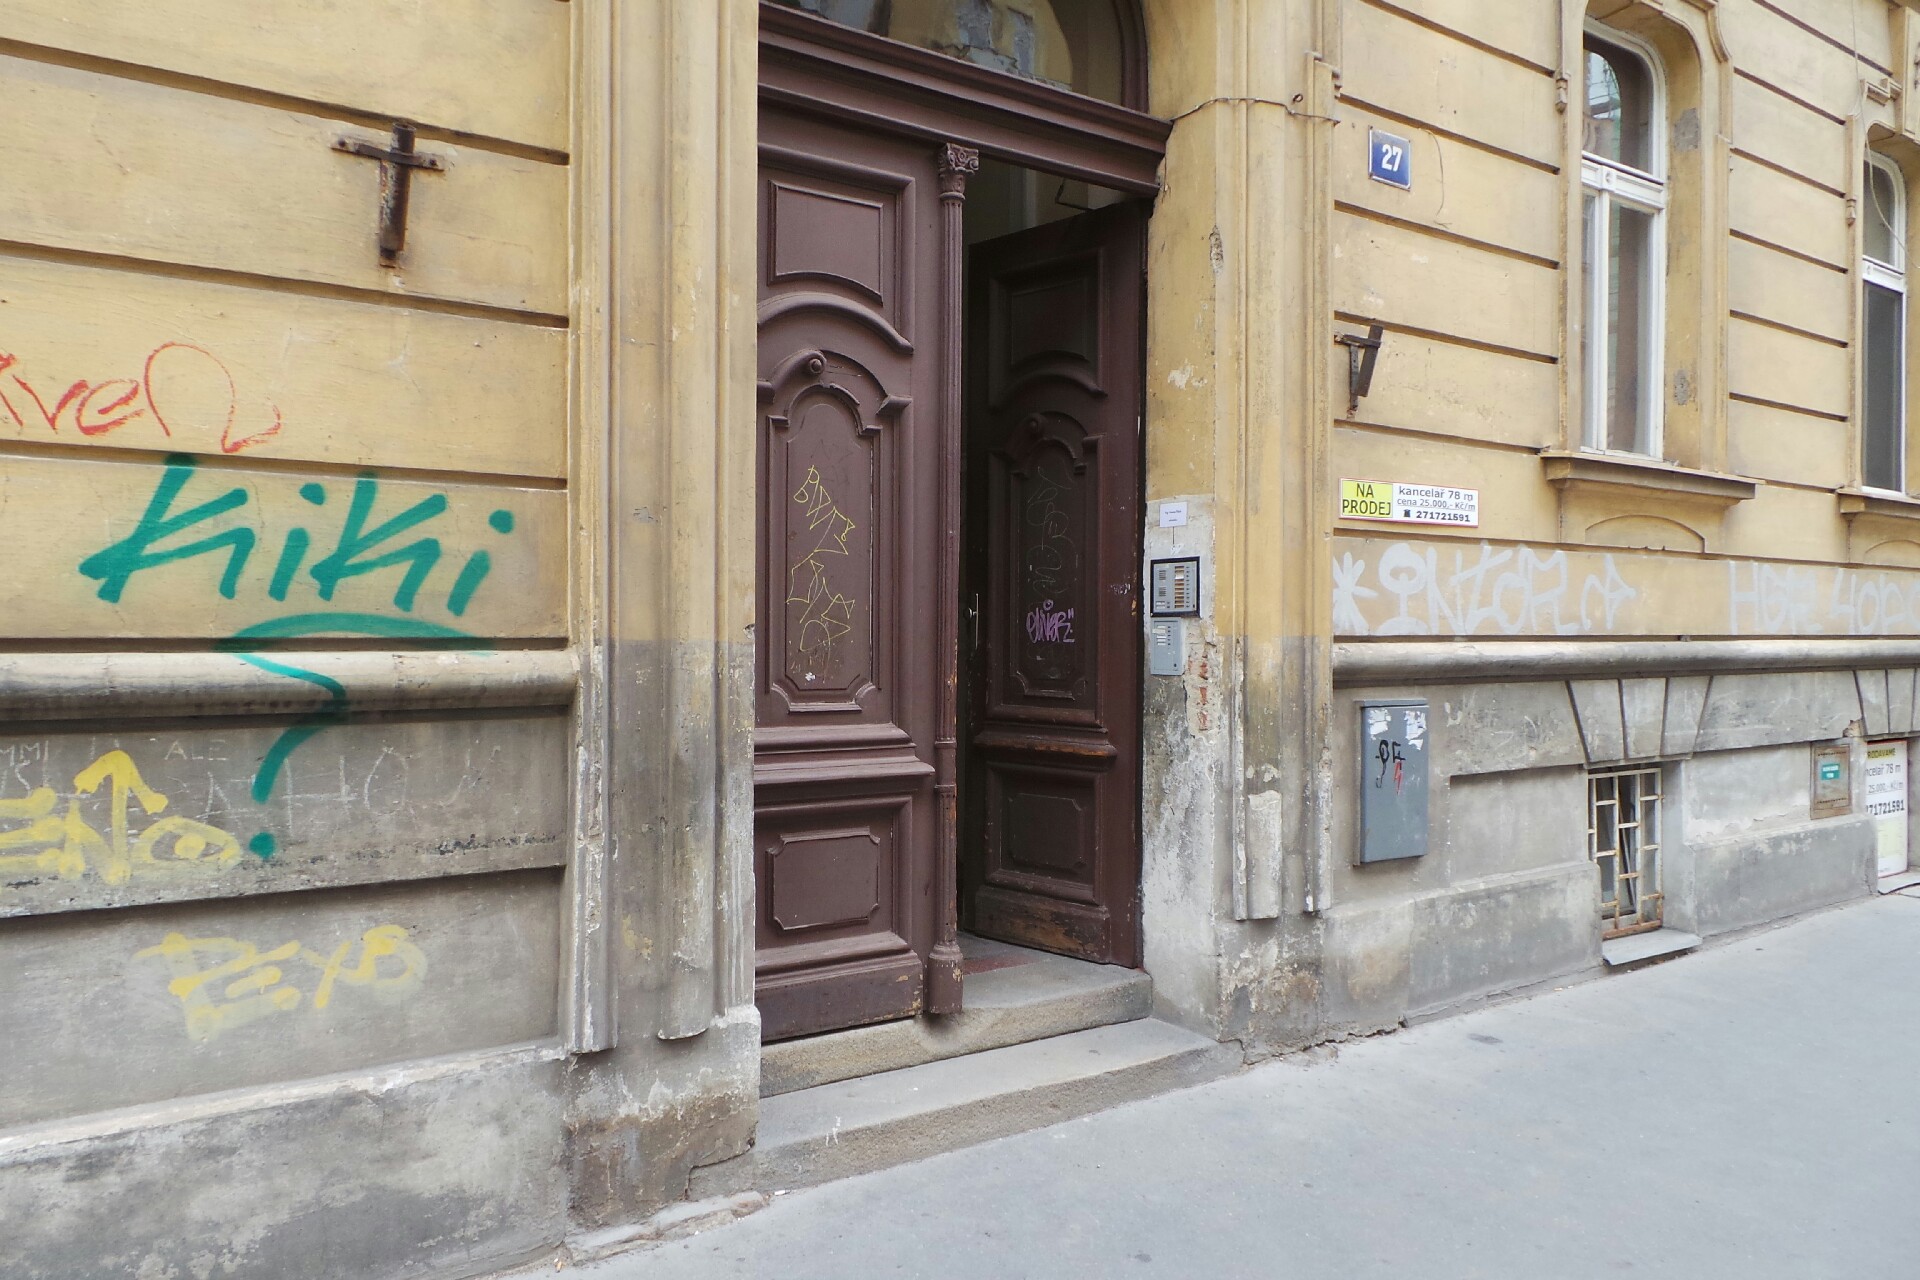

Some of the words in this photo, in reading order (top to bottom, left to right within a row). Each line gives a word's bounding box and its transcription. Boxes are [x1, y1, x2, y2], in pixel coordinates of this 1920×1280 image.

[1381, 143, 1403, 172] 27
[1356, 483, 1375, 498] NA
[1448, 490, 1461, 500] 78
[1342, 499, 1391, 516] PRODEJ
[1397, 498, 1417, 506] cena
[1416, 510, 1471, 523] 271721591
[1886, 763, 1894, 774] 78
